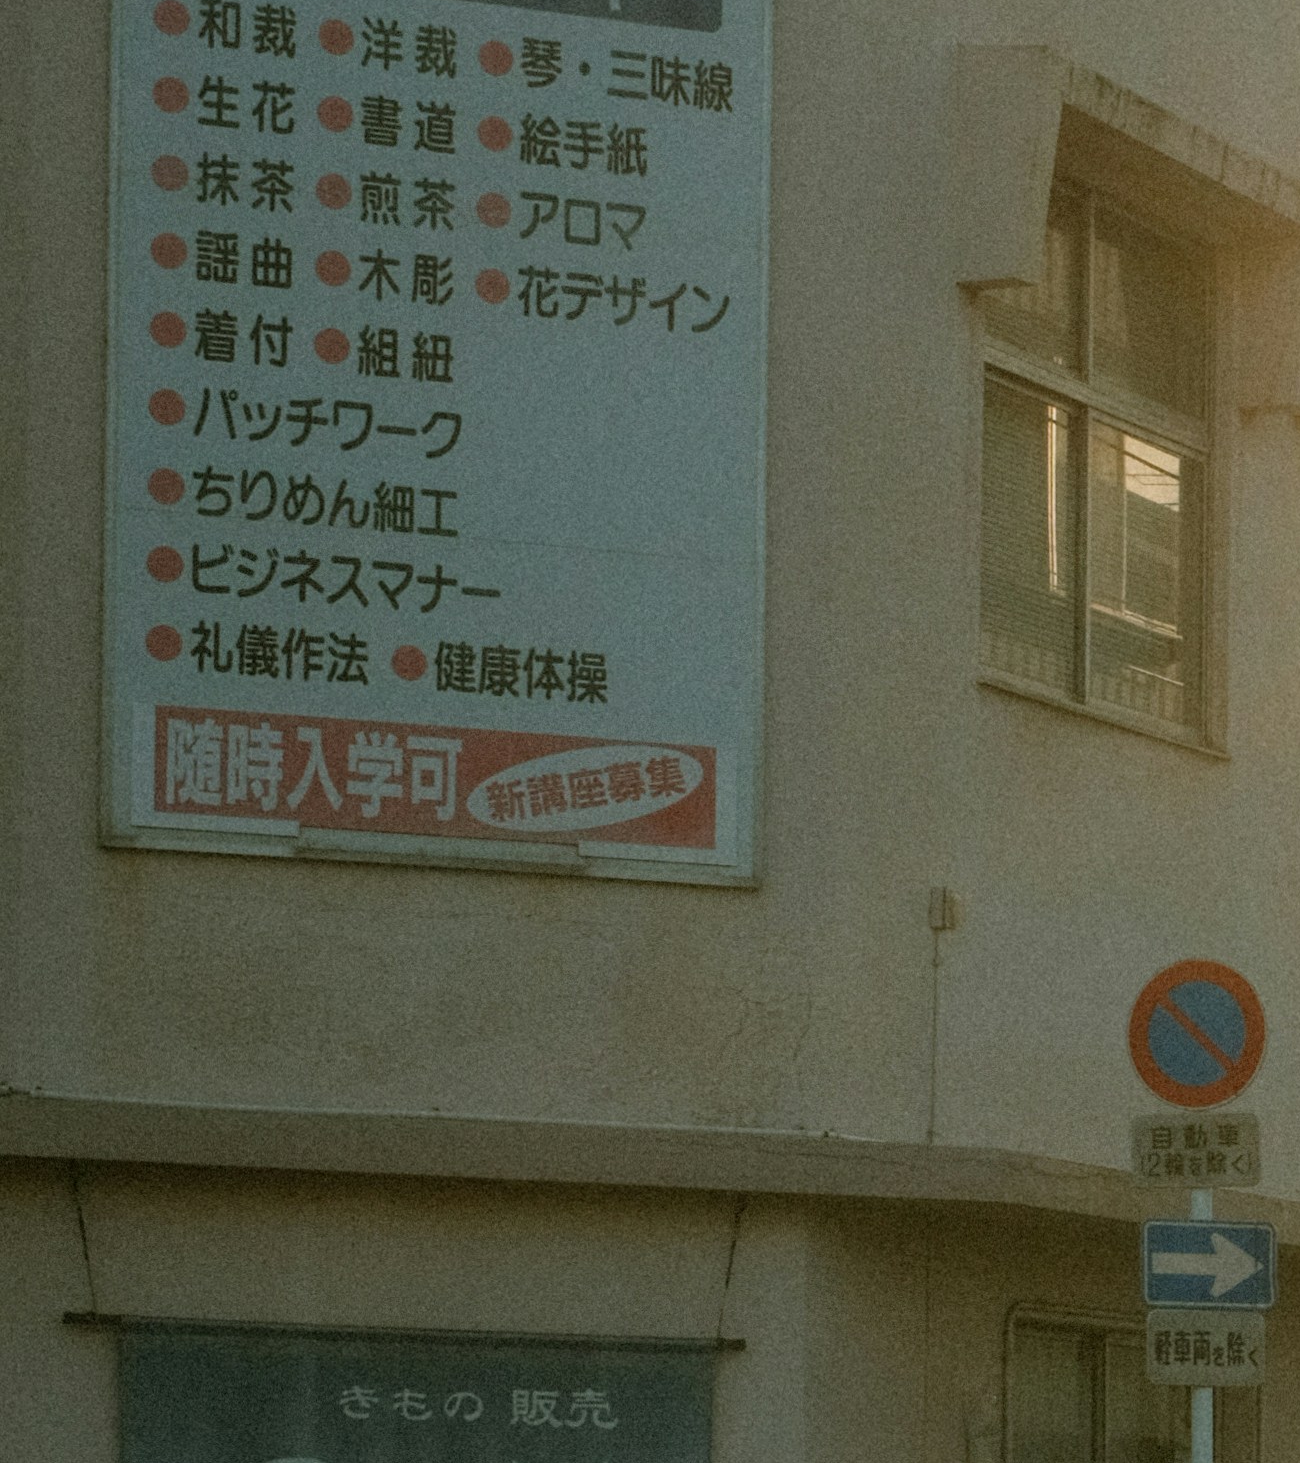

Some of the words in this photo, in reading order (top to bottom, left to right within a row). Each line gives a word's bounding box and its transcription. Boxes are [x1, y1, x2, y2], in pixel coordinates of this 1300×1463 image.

[360, 16, 458, 79] 洋裁
[520, 36, 734, 113] 琴・三味線
[197, 75, 296, 136] 生花
[360, 94, 457, 155] 書道
[518, 112, 648, 178] 絵手紙
[195, 151, 295, 213] 抹茶
[359, 170, 456, 231] 煎茶
[518, 190, 647, 251] アロマ
[195, 229, 293, 290] 謡曲
[358, 248, 454, 307] 木彫
[516, 264, 731, 334] 花デザイン
[194, 307, 294, 369] 着付
[357, 324, 454, 384] 組紐
[192, 387, 463, 460] パッチワーク
[191, 464, 459, 538] ちりめん細工
[190, 543, 501, 614] ビジネスマナー
[189, 619, 369, 686] 礼儀作法
[434, 639, 608, 705] 健康体操
[165, 717, 464, 822] 随時入学可
[485, 756, 686, 823] 新講座募集
[1151, 1125, 1240, 1150] 自動車
[1154, 1330, 1259, 1368] 軽車両を除く
[338, 1384, 485, 1423] きもの
[509, 1387, 620, 1432] 販売
